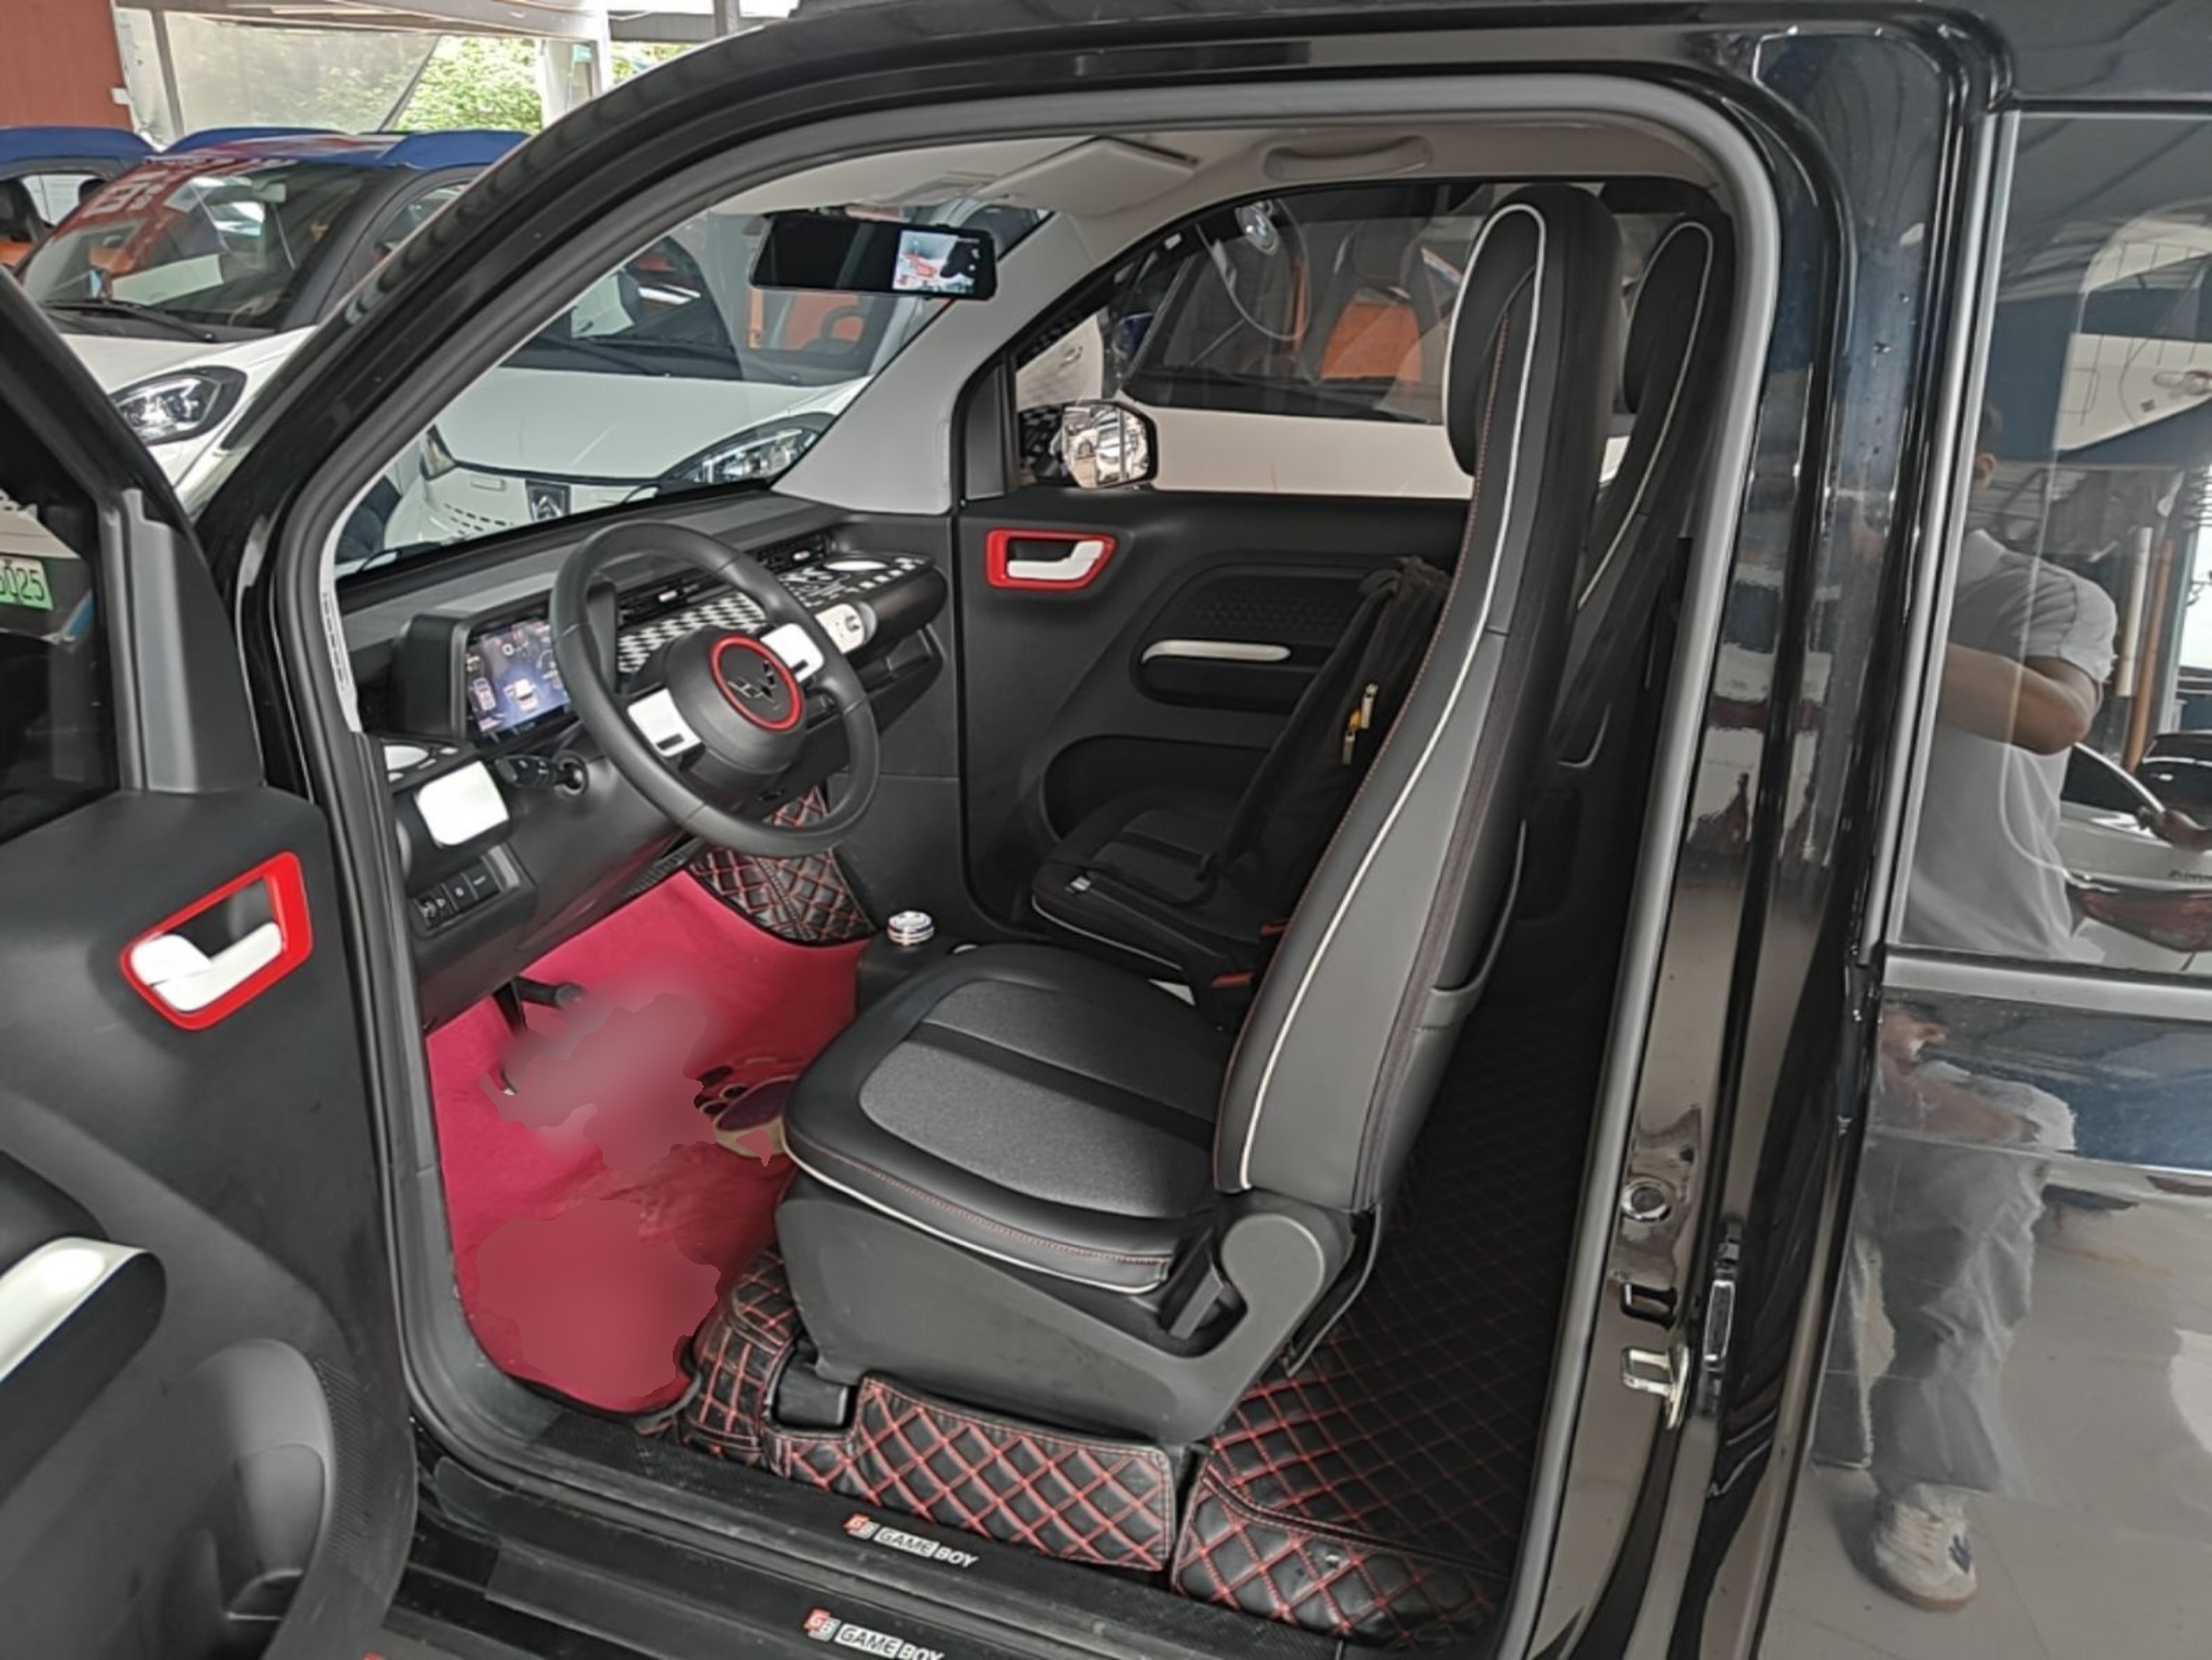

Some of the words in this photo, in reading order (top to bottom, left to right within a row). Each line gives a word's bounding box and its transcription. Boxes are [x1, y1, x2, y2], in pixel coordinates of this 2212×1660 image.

[0, 566, 44, 601] 025
[879, 1530, 934, 1553] GAME
[933, 1545, 979, 1568] BOY
[840, 1627, 899, 1654] GAME
